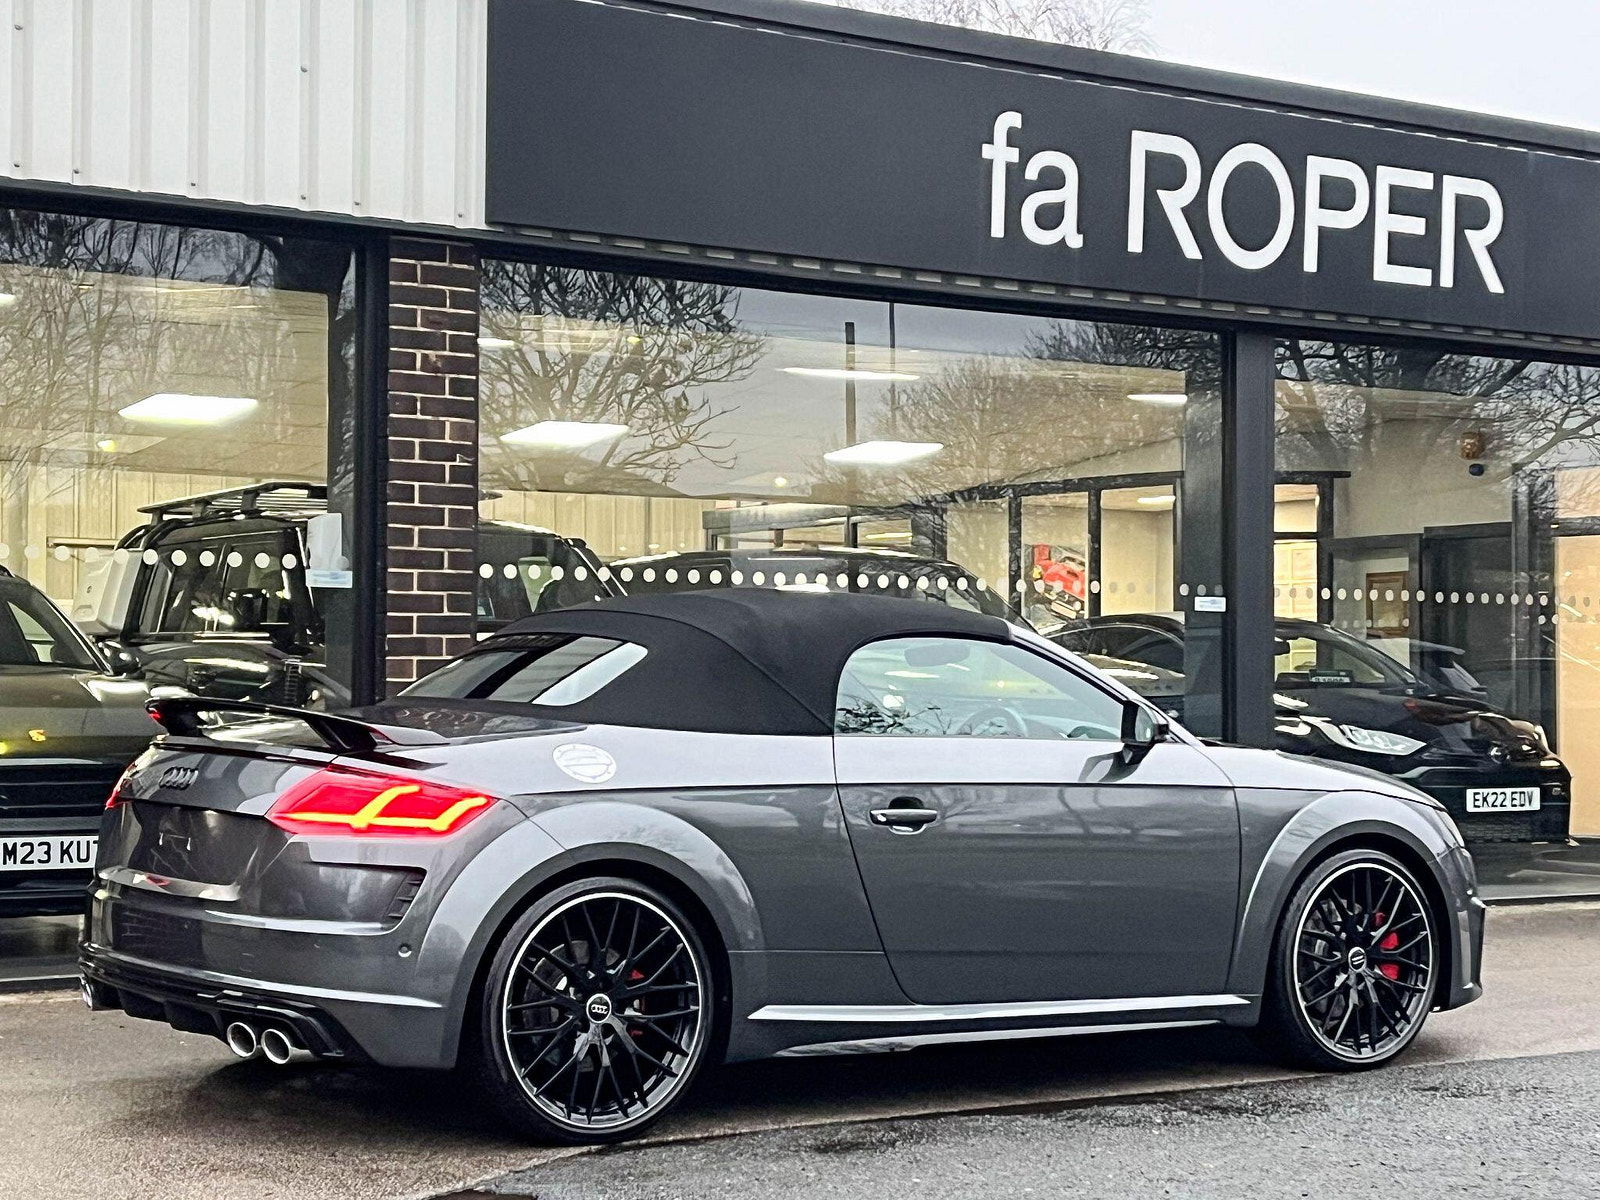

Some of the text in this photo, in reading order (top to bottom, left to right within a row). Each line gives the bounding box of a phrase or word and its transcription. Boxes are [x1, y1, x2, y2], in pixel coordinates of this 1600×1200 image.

[981, 111, 1505, 294] fa ROPER
[1473, 792, 1507, 808] EK22
[2, 840, 98, 865] M23 KU
